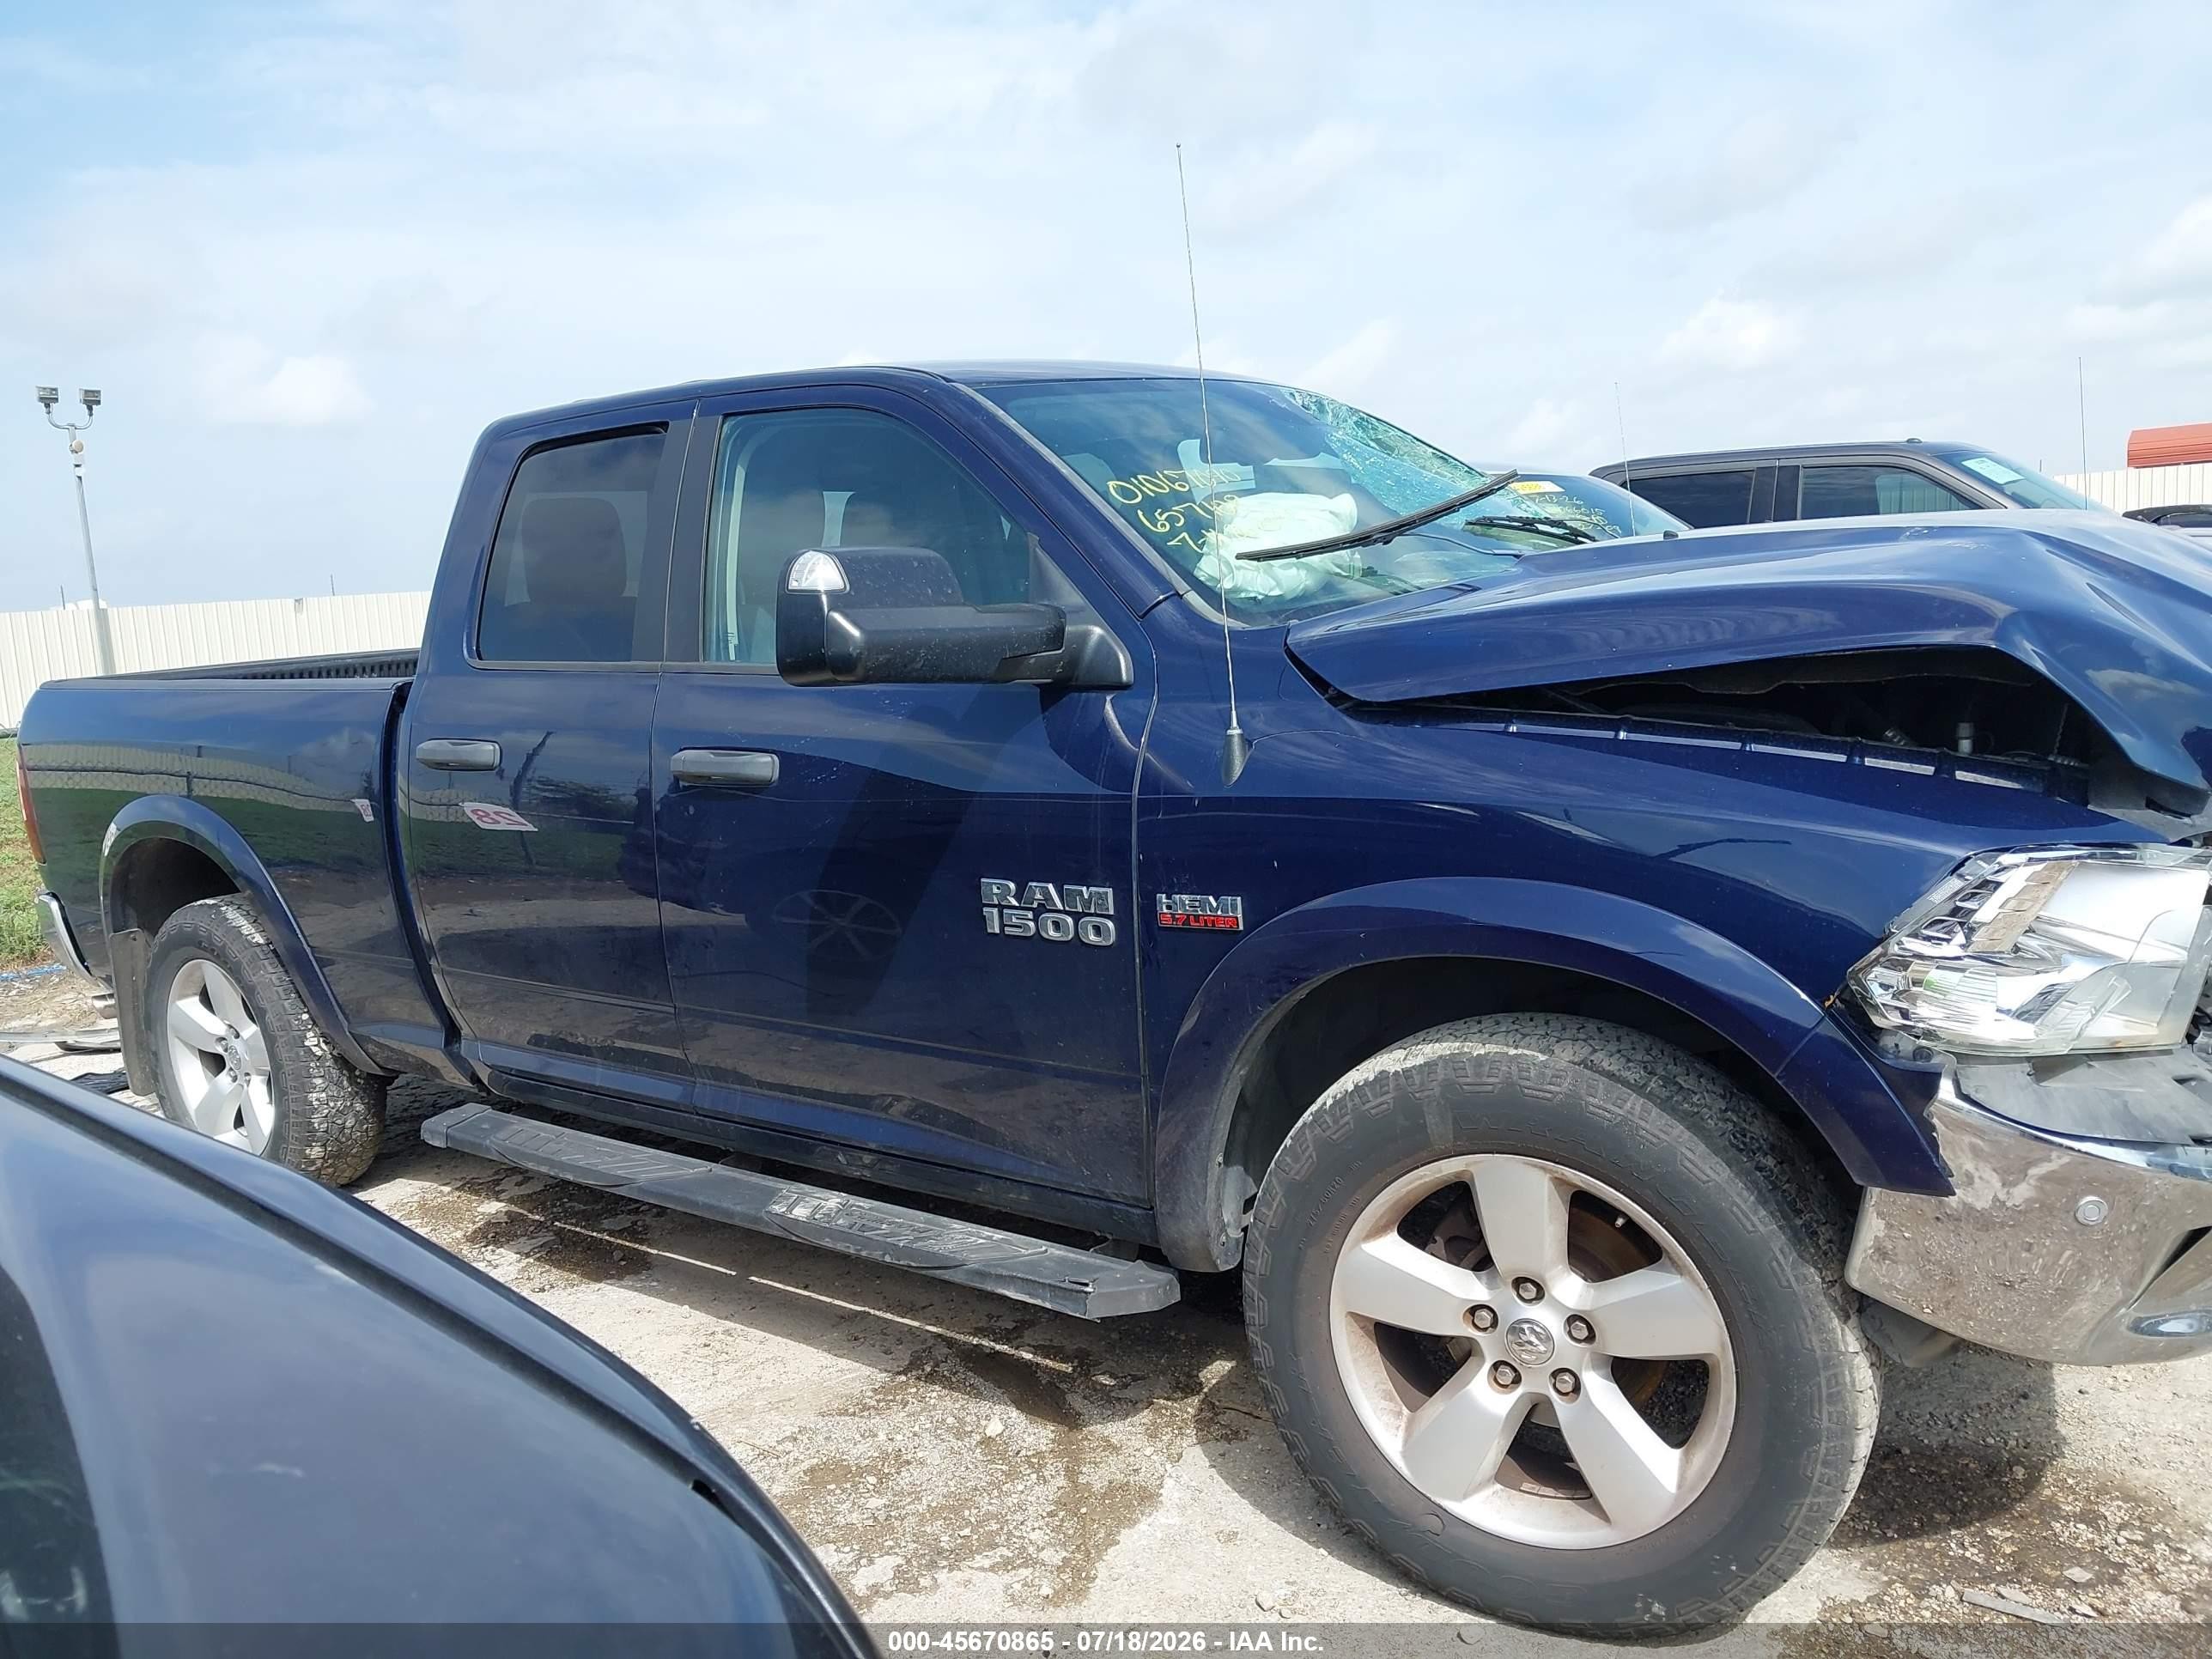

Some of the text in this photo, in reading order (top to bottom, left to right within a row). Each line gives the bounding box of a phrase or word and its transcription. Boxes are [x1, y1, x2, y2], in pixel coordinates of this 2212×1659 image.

[981, 878, 1115, 915] RAM
[1156, 894, 1243, 915] HEMI
[982, 907, 1116, 946] 1500
[1160, 914, 1238, 927] 5.7 LITER
